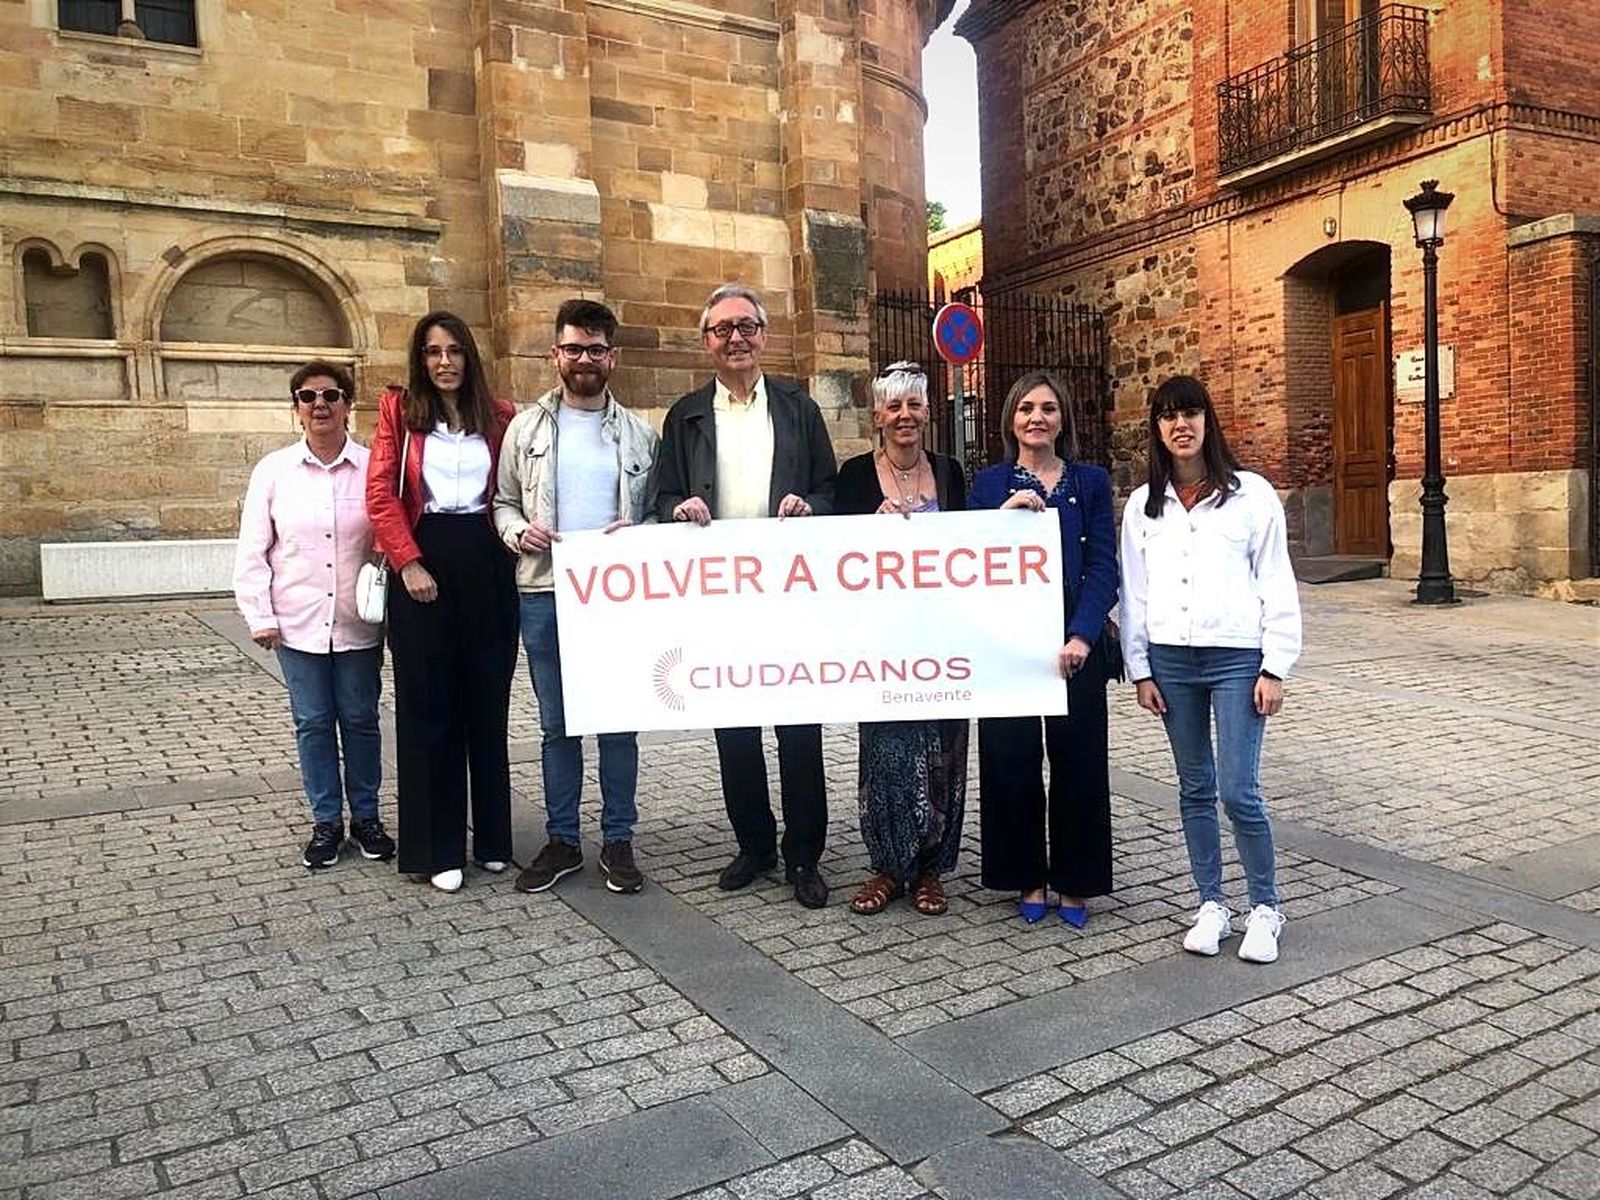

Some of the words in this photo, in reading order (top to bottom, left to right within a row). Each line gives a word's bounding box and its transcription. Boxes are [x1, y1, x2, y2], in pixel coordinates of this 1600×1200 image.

[565, 555, 764, 605] VOLVER
[783, 554, 818, 593] A
[836, 545, 1051, 592] CRECER
[689, 656, 972, 690] CIUDADANOS
[881, 688, 973, 704] Benavente
